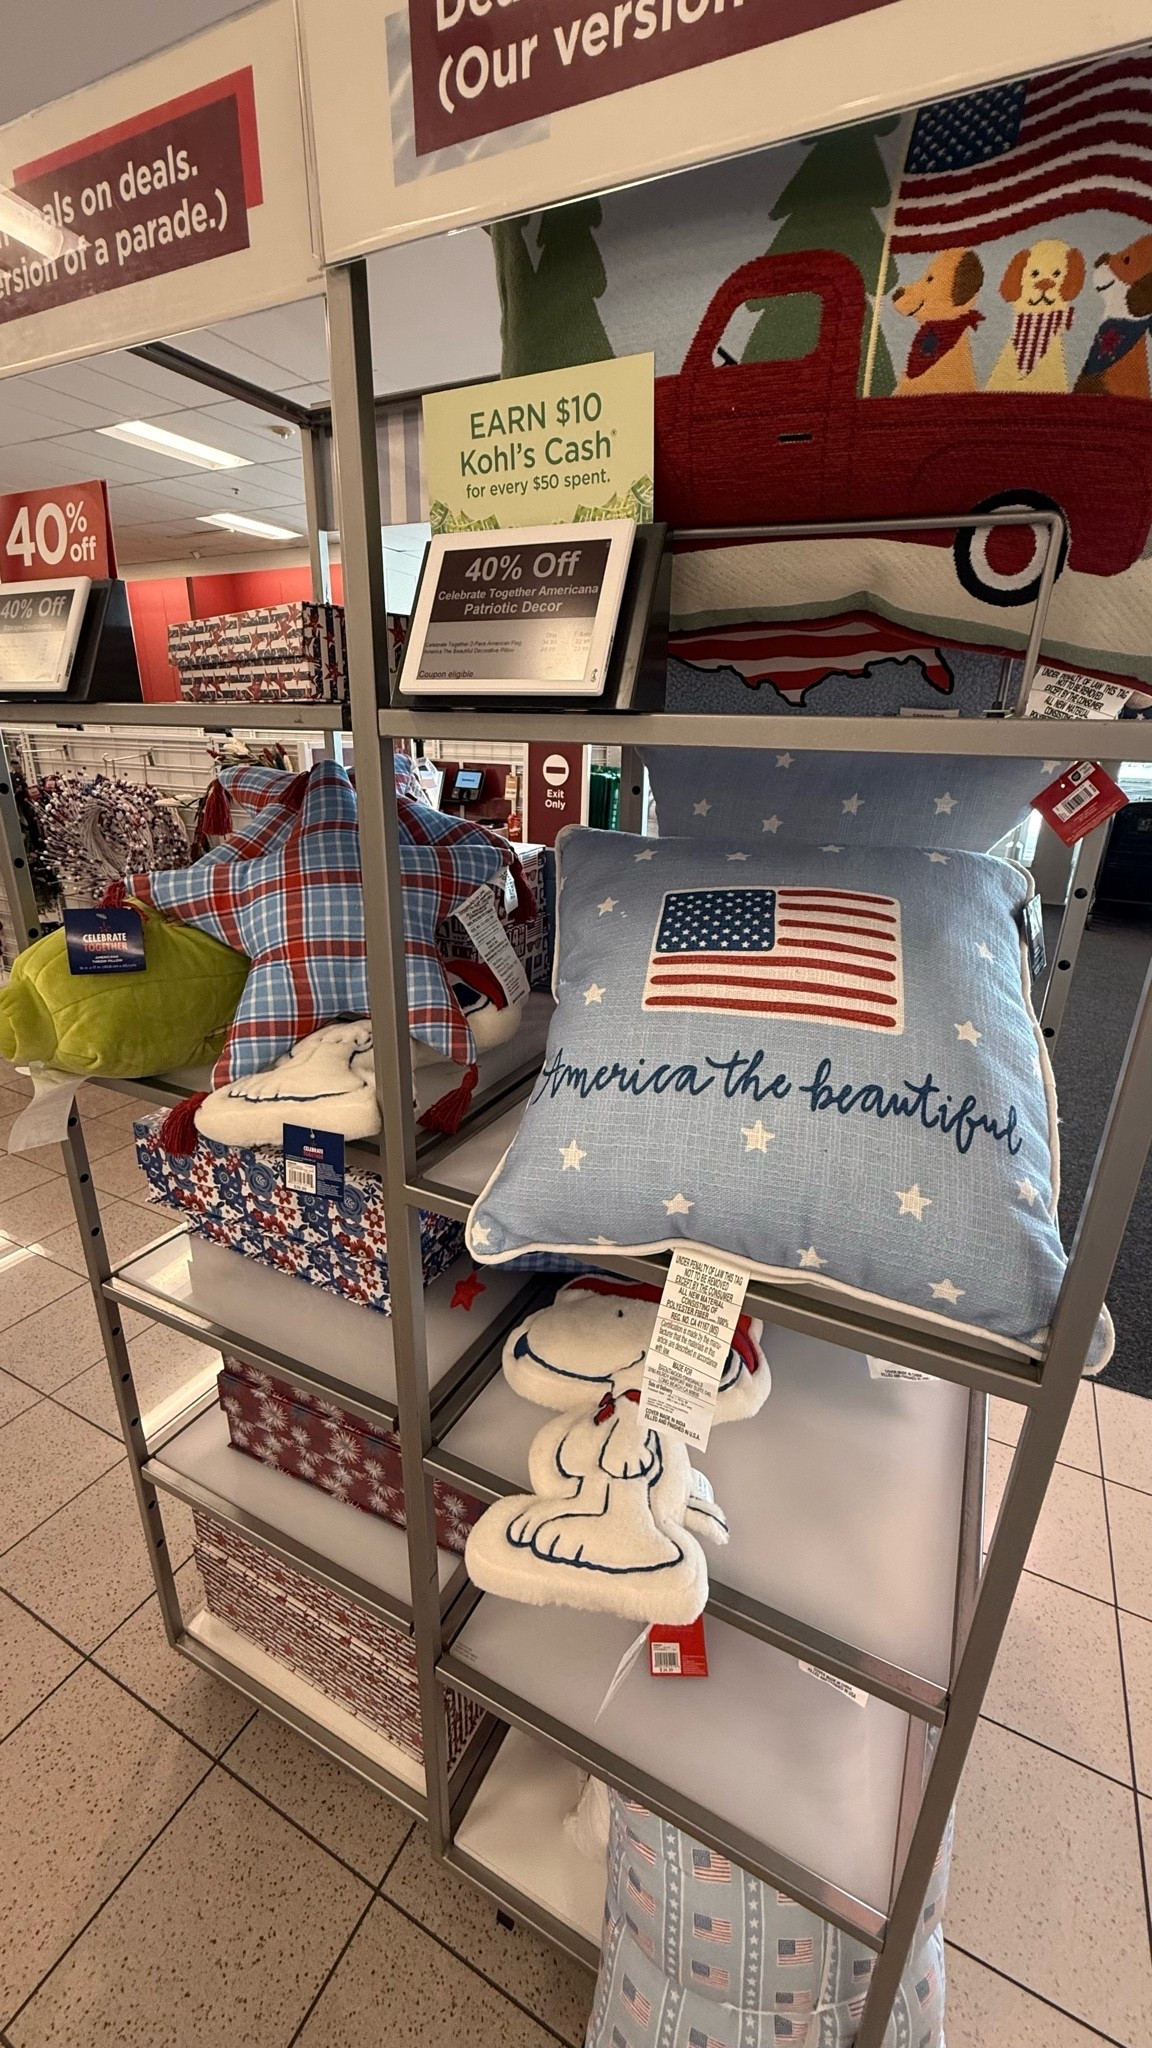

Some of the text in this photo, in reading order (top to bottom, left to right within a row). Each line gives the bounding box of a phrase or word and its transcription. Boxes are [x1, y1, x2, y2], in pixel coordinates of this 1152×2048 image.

[438, 34, 537, 114] (Our
[81, 181, 112, 216] on
[119, 144, 198, 202] deals.
[64, 235, 88, 276] of
[94, 237, 110, 266] a
[115, 188, 228, 266] parade.)
[470, 392, 603, 440] EARN $10
[460, 442, 536, 477] Kohl's
[466, 469, 611, 498] for every $50 spent.
[5, 501, 97, 567] 40% off
[464, 550, 583, 582] 40% Off
[438, 584, 600, 601] Celebrate Together Americana
[0, 596, 67, 619] 40% Off
[464, 600, 563, 616] Patriotic Decor
[418, 670, 474, 680] Coupon eligible
[1042, 667, 1059, 678] UNDER
[1060, 673, 1082, 683] PENALTY
[1090, 680, 1103, 690] LAW
[1103, 684, 1117, 695] THIS
[1117, 688, 1129, 698] TAG
[1044, 684, 1103, 710] EXCEPT BY THE CONSUMER
[1056, 677, 1103, 700] NOT TO BE REMOVED
[1044, 696, 1054, 705] ALL
[1053, 699, 1066, 709] NEW
[1066, 704, 1089, 718] MATERIAL
[546, 789, 565, 799] Exit
[544, 800, 566, 811] Only
[82, 932, 127, 943] CELEBRATE
[83, 942, 128, 952] TOGETHER
[530, 1046, 1024, 1155] America the beautiful
[676, 1256, 743, 1285] UNDER PENALTY OF LAW THIS TAG
[684, 1268, 729, 1290] NOT TO BE REMOVED
[675, 1275, 733, 1302] EXCEPT BY THE CONSUMER
[678, 1287, 723, 1308] ALL NEW MATERIAL
[666, 1299, 694, 1314] POLYESTER
[694, 1309, 709, 1319] FIBER
[681, 1297, 709, 1311] CONSISTING
[671, 1312, 680, 1321] REG.
[672, 1362, 692, 1375] MADE FOR
[645, 1413, 657, 1422] FILLED
[667, 1422, 684, 1432] FINISHED
[646, 1408, 659, 1416] COVER
[660, 1413, 670, 1421] MADE
[676, 1419, 685, 1427] INDIA
